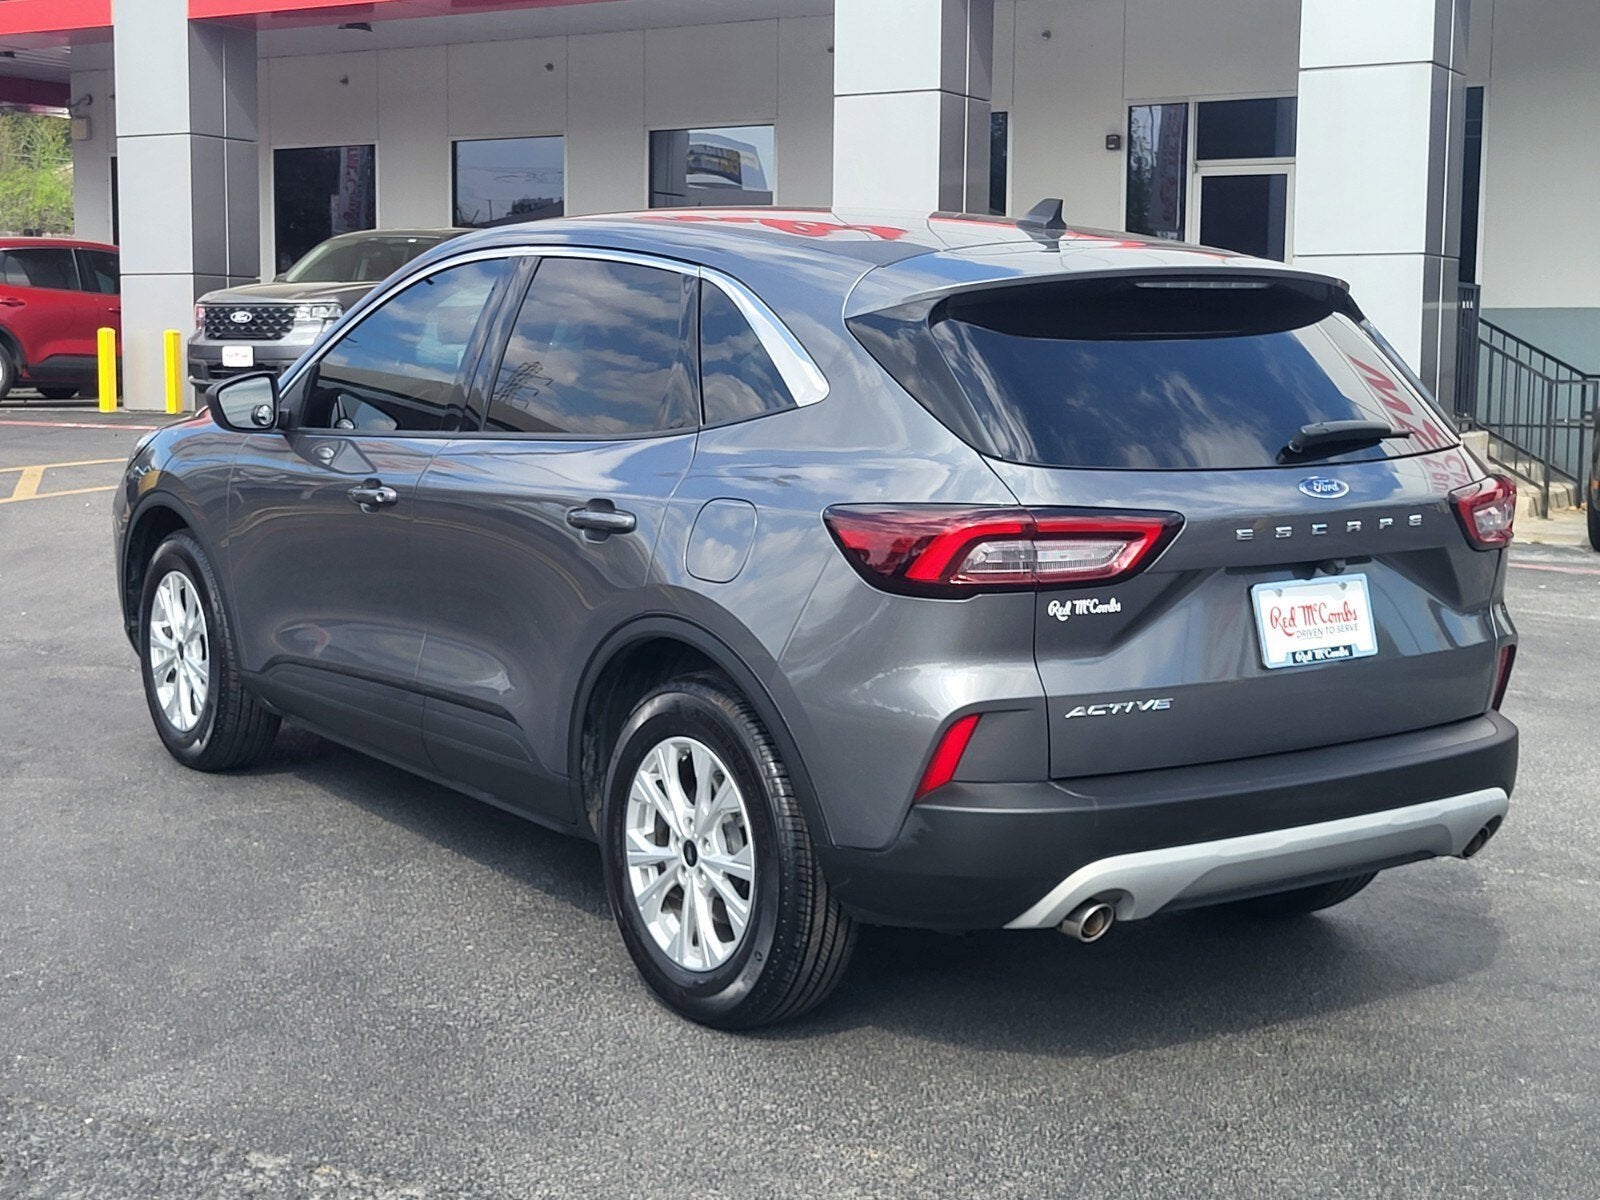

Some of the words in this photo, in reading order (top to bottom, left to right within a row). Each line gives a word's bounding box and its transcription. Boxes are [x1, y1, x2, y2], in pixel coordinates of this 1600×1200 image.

[1313, 480, 1340, 493] Ford
[1235, 514, 1422, 540] ESCAPE
[1048, 600, 1071, 621] Red
[1073, 597, 1121, 615] McCombs
[1270, 605, 1297, 637] Red
[1298, 601, 1358, 626] McCombs
[1296, 628, 1324, 639] DRIVEN
[1325, 625, 1335, 634] TO
[1337, 623, 1359, 633] SERVE
[1064, 697, 1174, 719] ACTIVE
